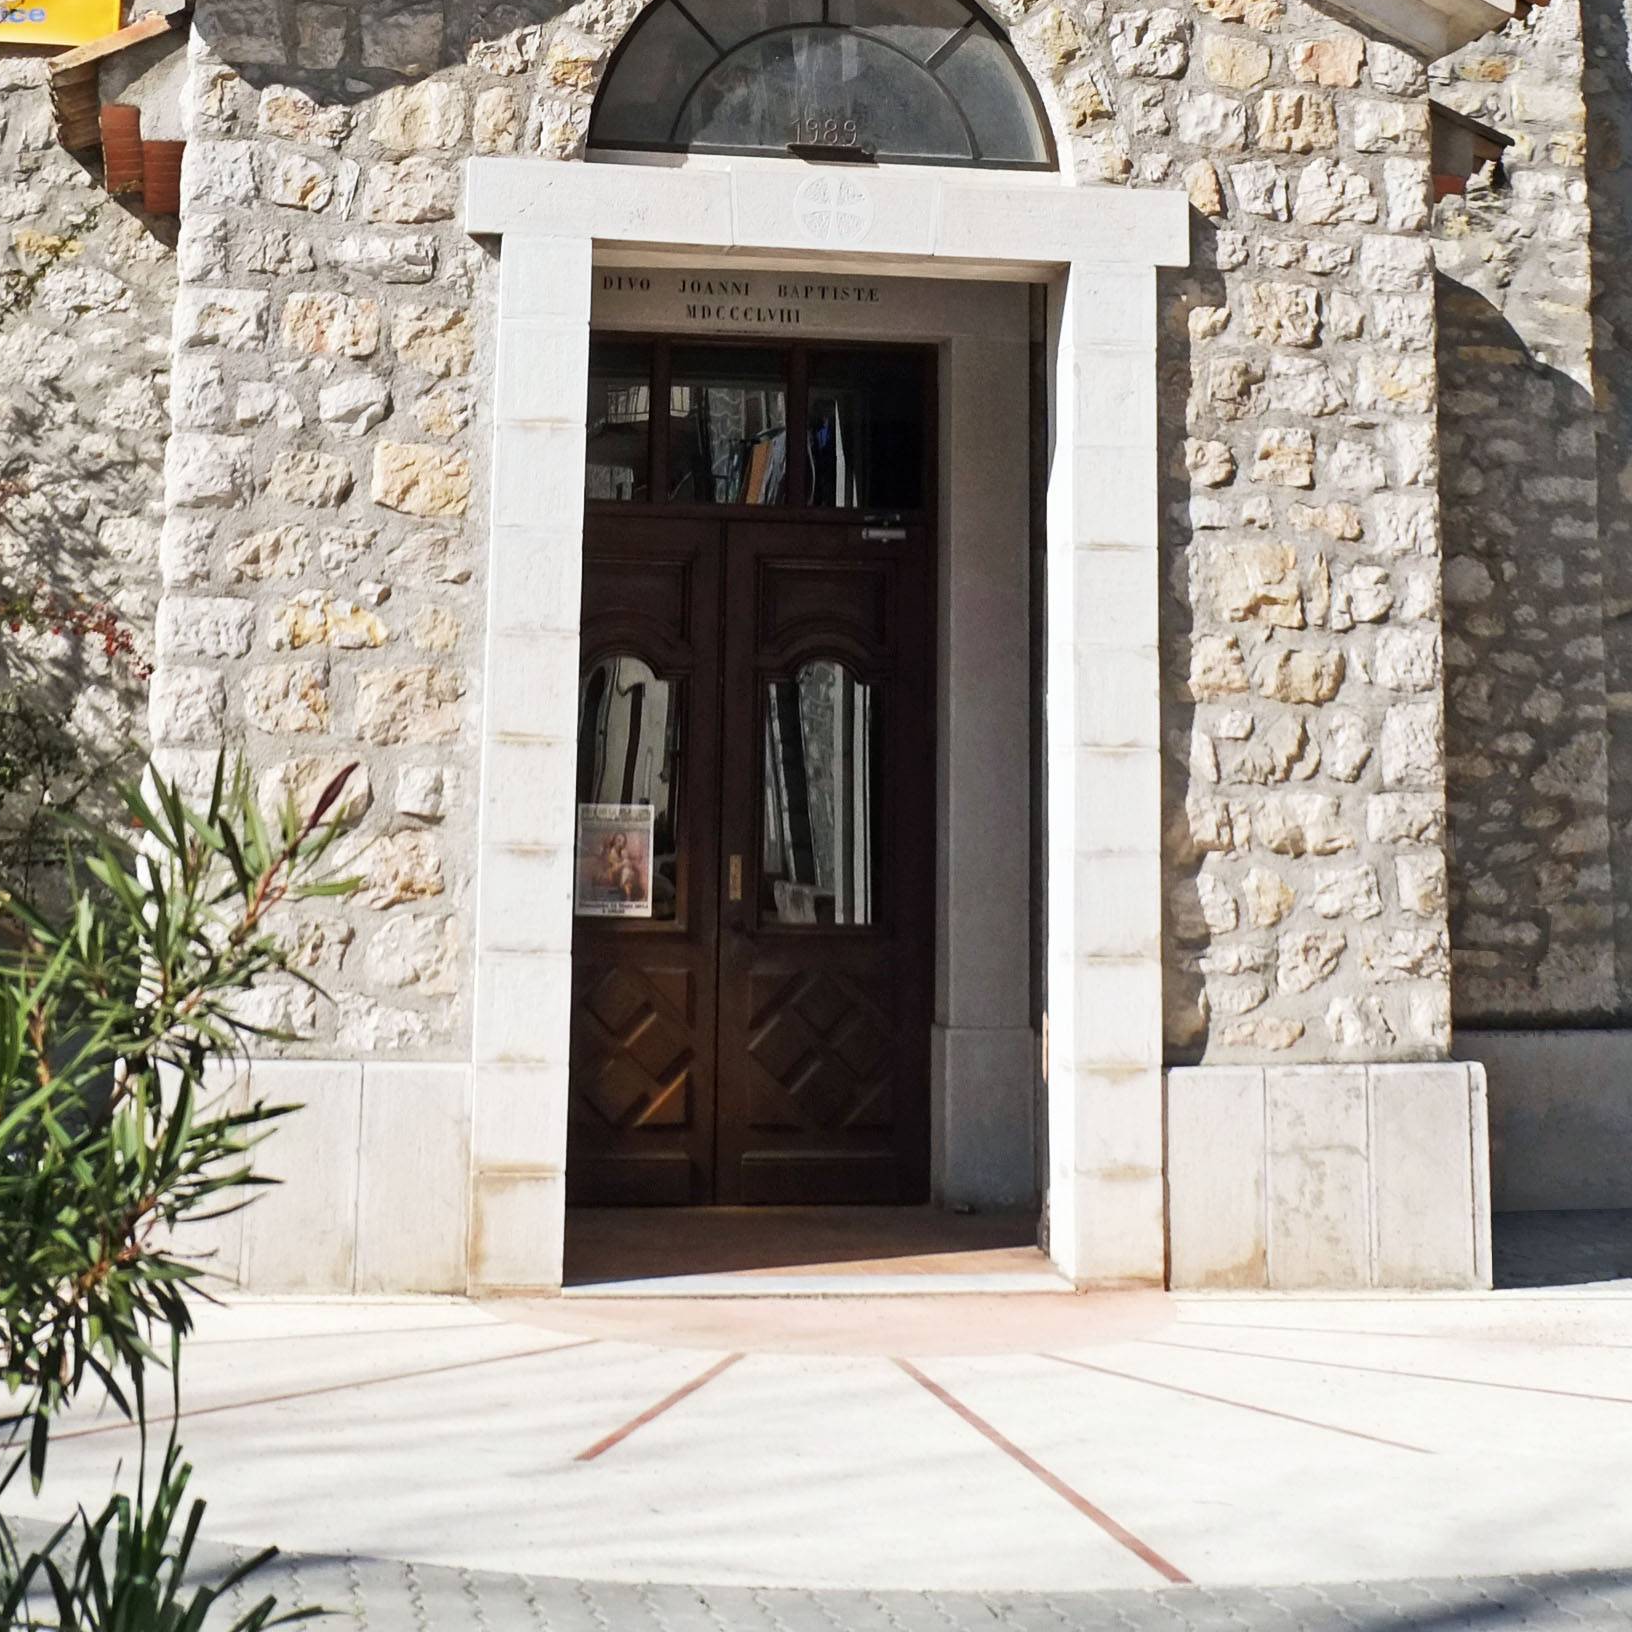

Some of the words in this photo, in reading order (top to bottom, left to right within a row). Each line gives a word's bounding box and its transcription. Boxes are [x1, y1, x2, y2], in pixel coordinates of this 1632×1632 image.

[792, 117, 857, 146] 1989
[602, 275, 651, 292] DIVO
[678, 279, 750, 296] JOANNI
[777, 283, 881, 303] BAPTISTÆ
[685, 304, 802, 324] MDCCCLVIII
